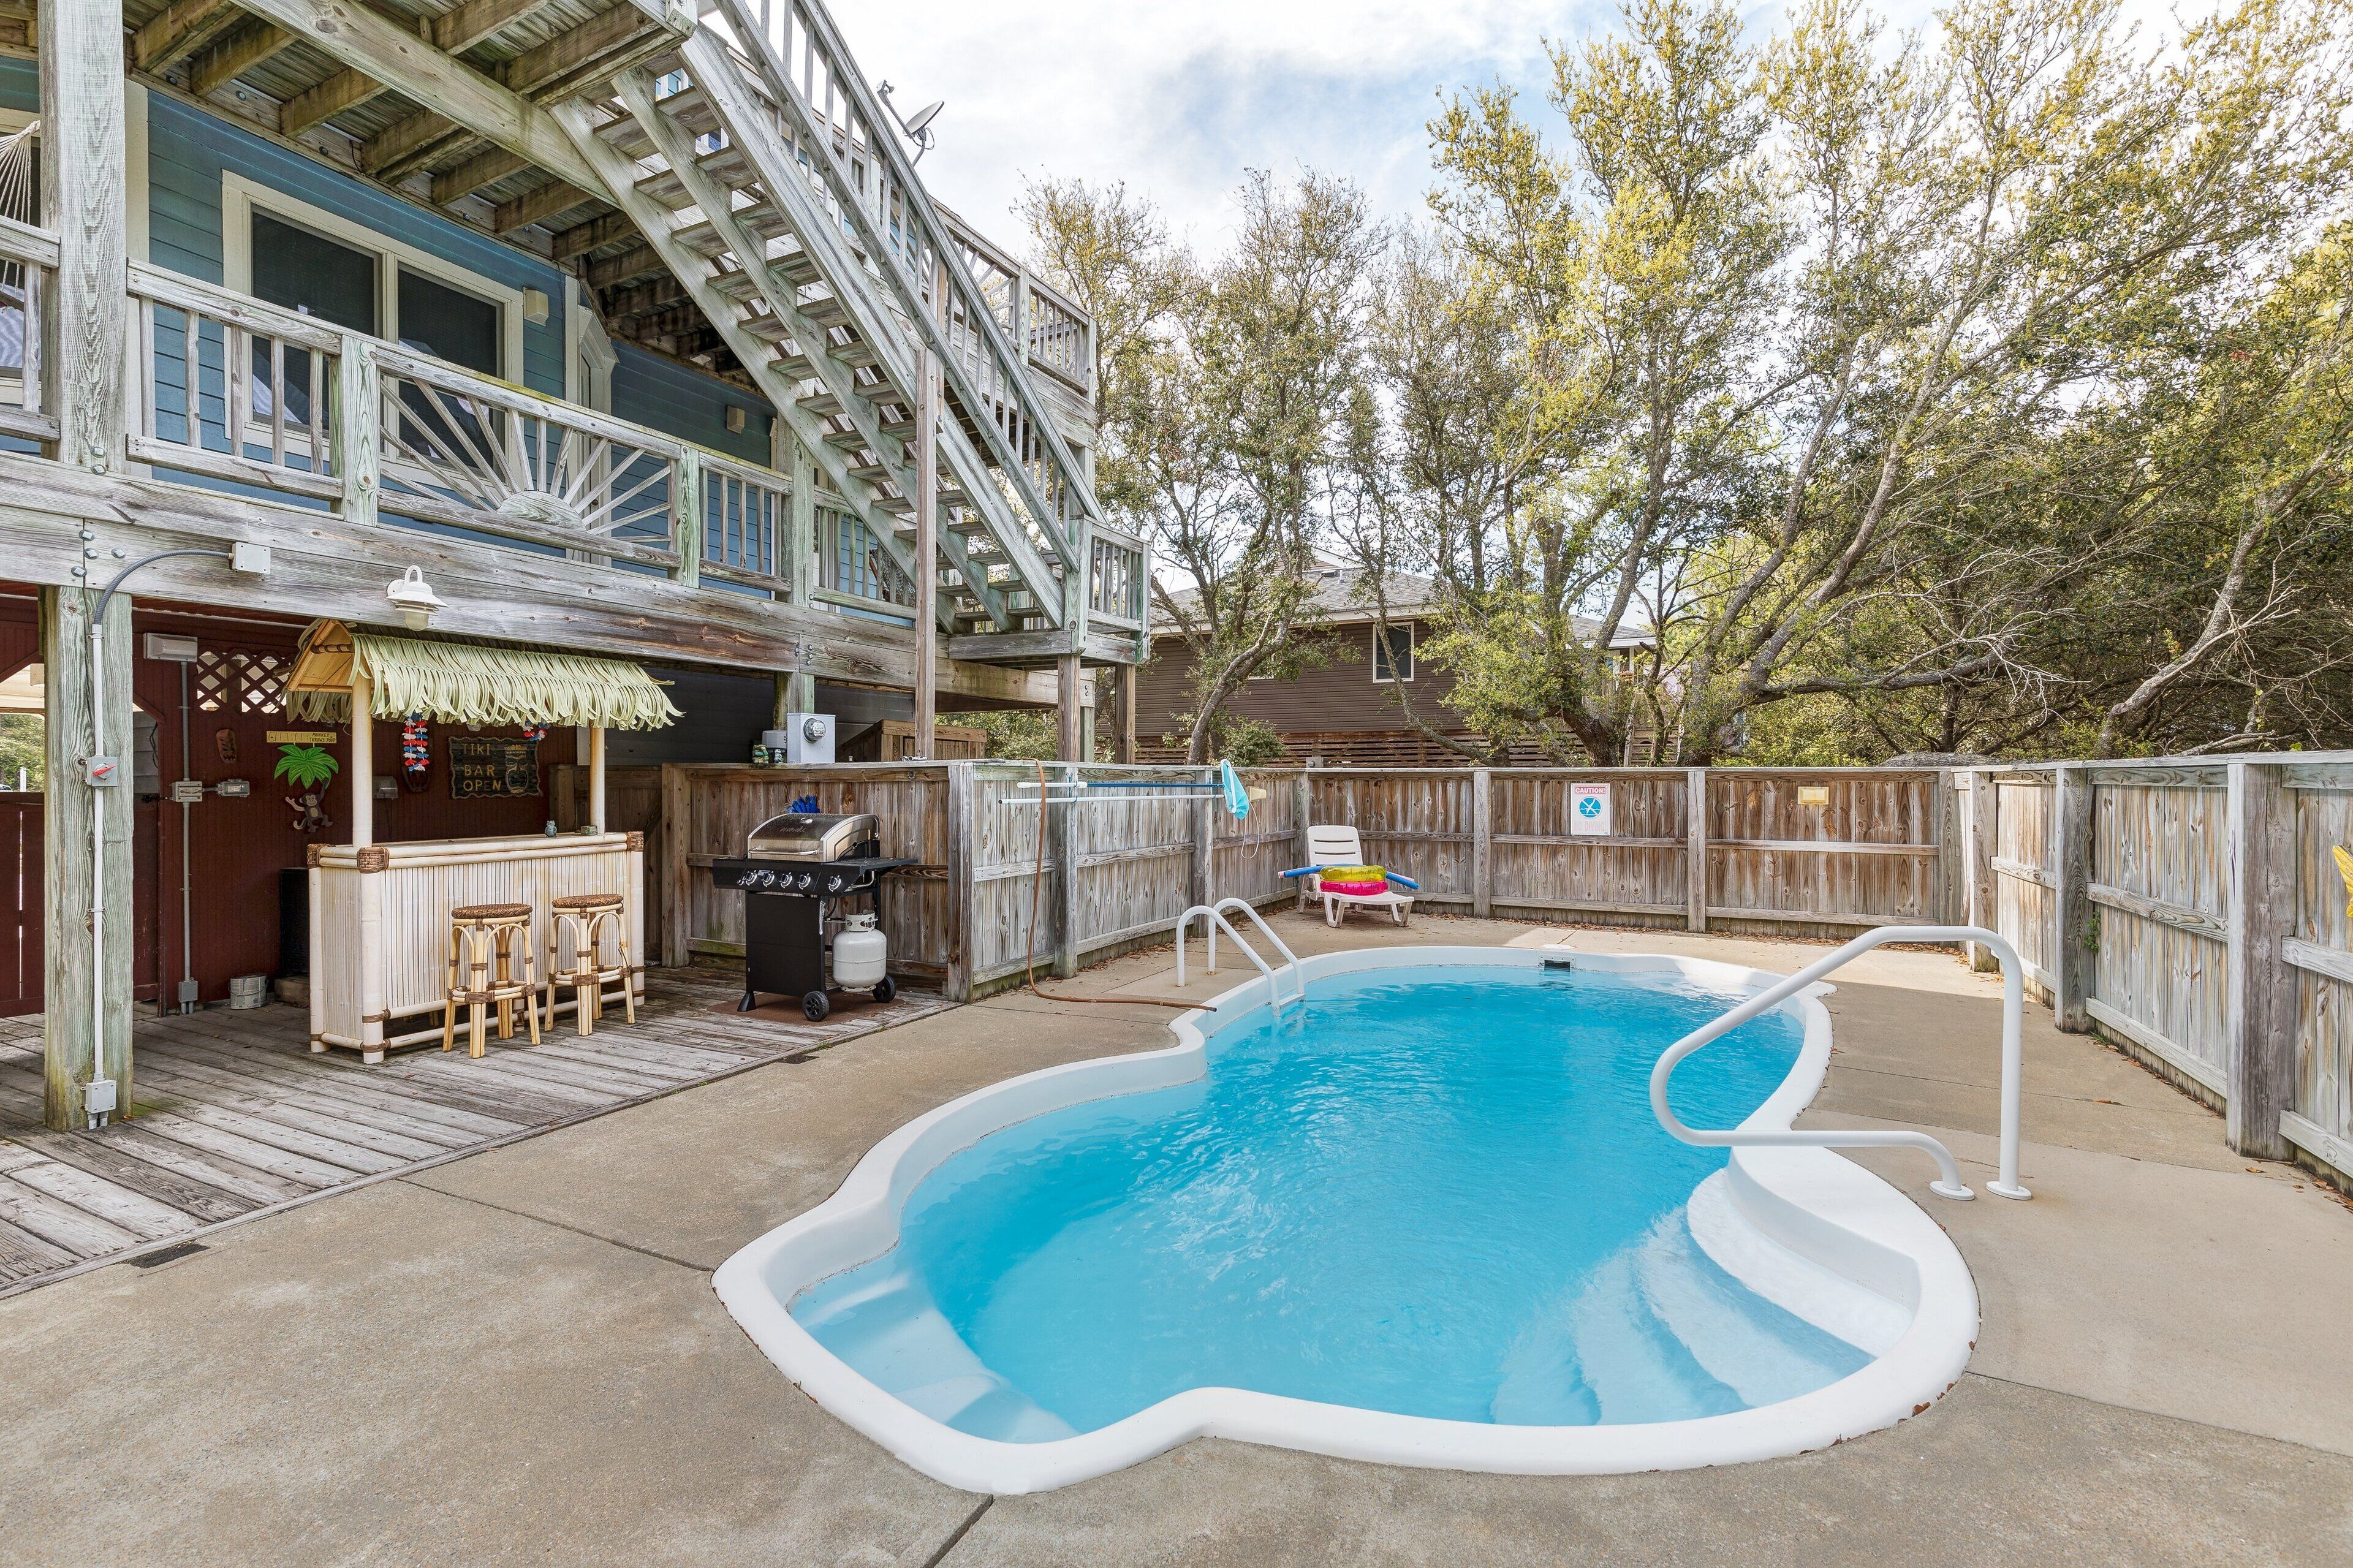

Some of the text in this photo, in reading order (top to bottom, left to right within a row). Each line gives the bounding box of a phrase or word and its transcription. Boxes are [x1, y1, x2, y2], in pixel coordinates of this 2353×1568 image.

[461, 743, 490, 756] TIKI
[464, 764, 495, 776] BAR
[463, 779, 501, 792] OPEN
